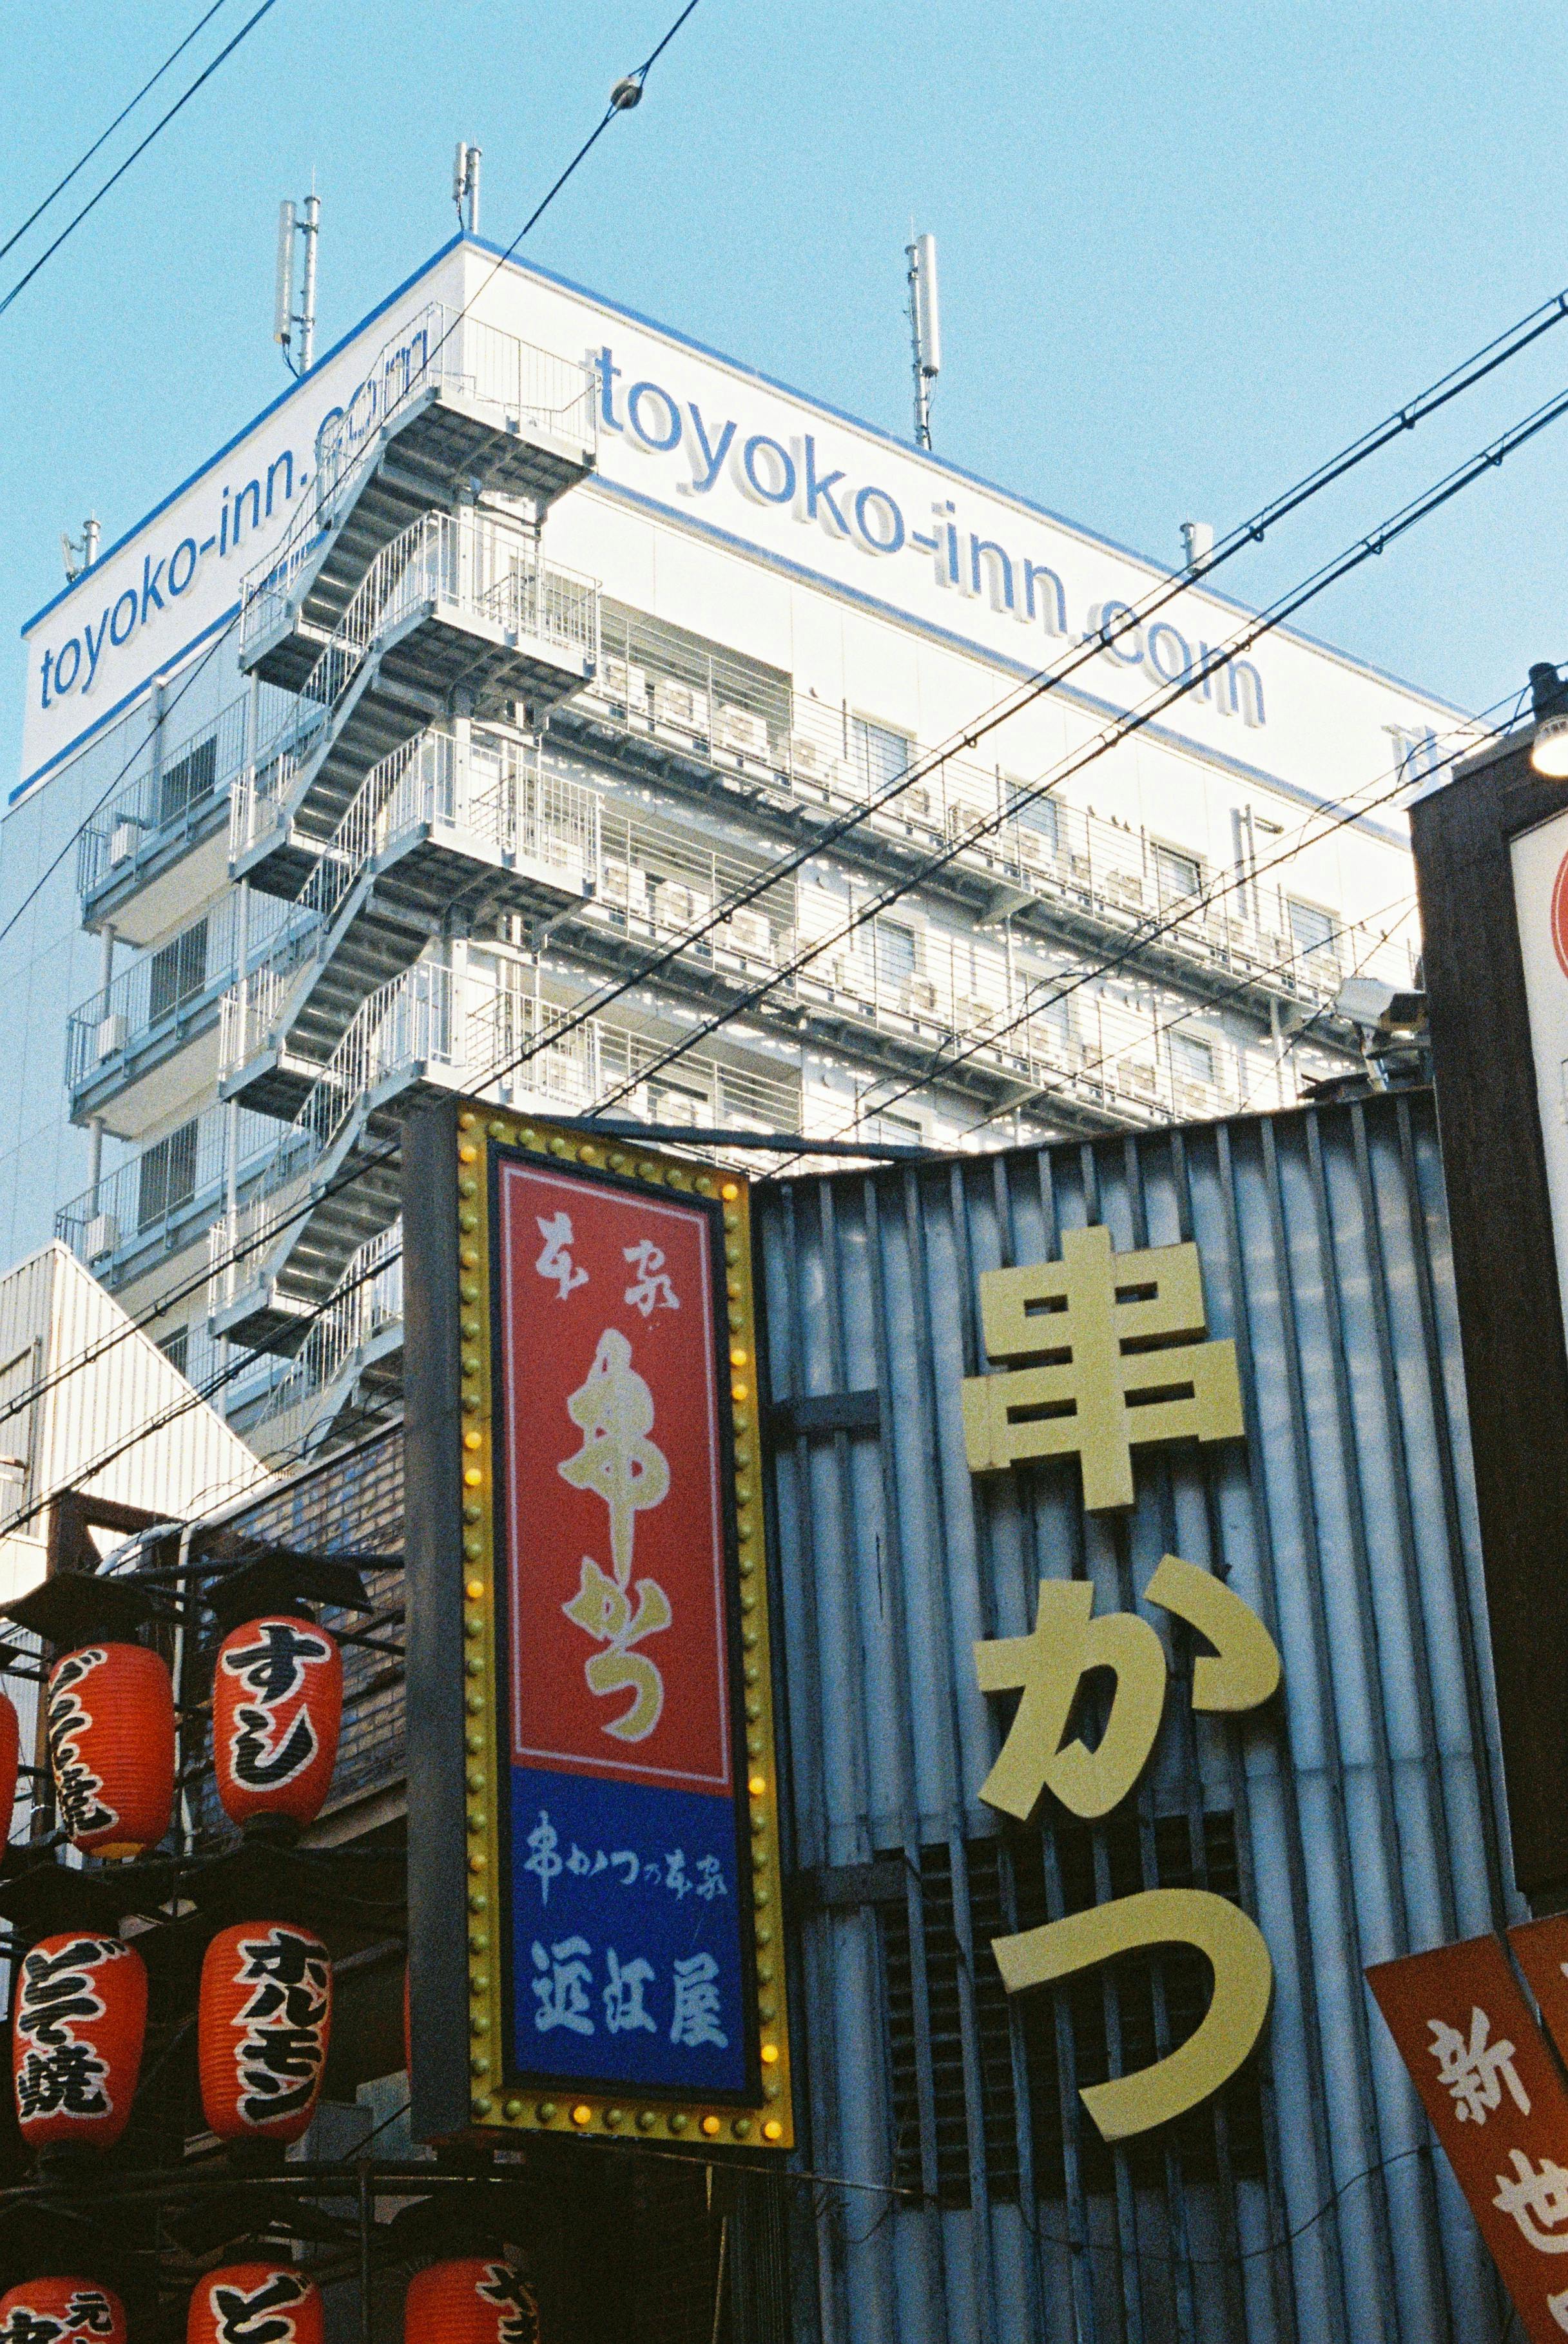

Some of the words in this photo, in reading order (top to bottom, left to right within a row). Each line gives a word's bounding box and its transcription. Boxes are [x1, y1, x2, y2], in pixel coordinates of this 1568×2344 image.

[592, 345, 1266, 726] toyoko-inn.com
[556, 1325, 672, 1744] 串かつ
[960, 1224, 1282, 2143] 串かつ
[231, 1927, 331, 2127] ホルモン
